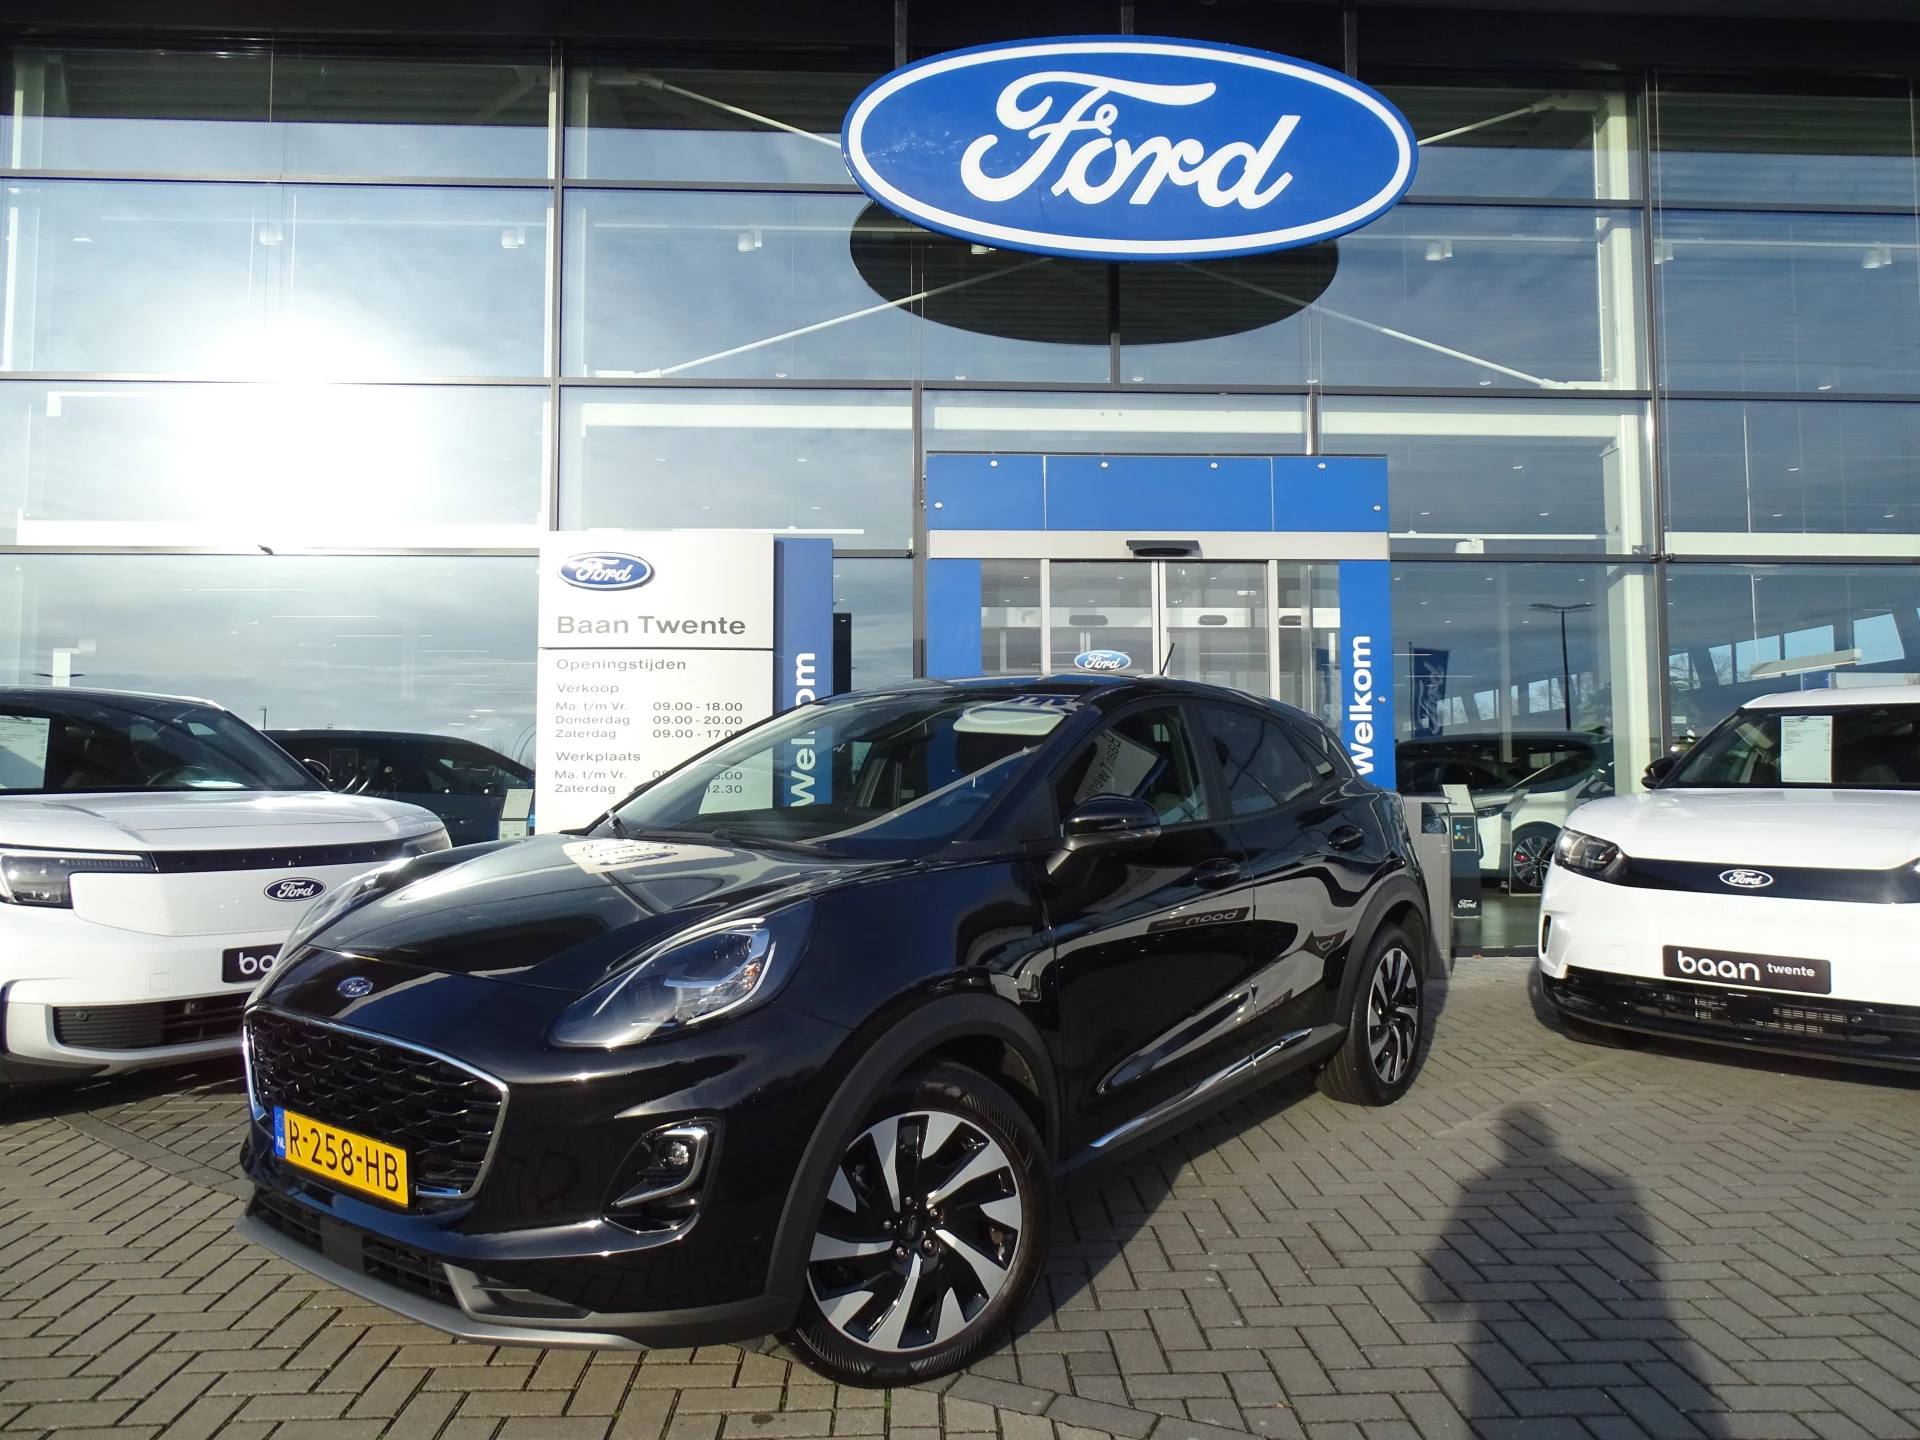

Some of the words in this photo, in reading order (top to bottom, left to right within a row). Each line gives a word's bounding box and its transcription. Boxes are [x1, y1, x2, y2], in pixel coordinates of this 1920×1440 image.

[960, 71, 1301, 209] Ford
[575, 557, 634, 582] Ford
[556, 615, 629, 634] Baan
[637, 615, 746, 635] Twente
[556, 658, 687, 672] Openingstijden
[1084, 653, 1121, 669] Ford
[556, 683, 620, 696] Verkoop
[555, 701, 580, 711] Ma.
[583, 701, 607, 712] t/m
[611, 701, 628, 711] Vr.
[652, 702, 693, 711] 09.00
[705, 702, 743, 712] 18.00
[1349, 635, 1374, 776] Welkom
[555, 715, 631, 726] Donderdag
[652, 716, 693, 725] 09.00
[703, 716, 743, 726] 20.00
[555, 729, 617, 740] Zaterdag
[652, 729, 693, 739] 09.00
[790, 652, 816, 807] Welom
[555, 751, 641, 763] Werkplaats
[554, 770, 579, 779] Ma.
[582, 769, 606, 780] t/m
[610, 770, 627, 779] Vr.
[554, 784, 616, 795] Zaterdag
[707, 784, 743, 794] 12.30
[1728, 871, 1764, 886] Ford
[277, 881, 314, 898] Ford
[238, 952, 277, 975] ba
[1677, 950, 1761, 982] baan
[1766, 962, 1816, 978] twente
[277, 1135, 286, 1149] NL
[288, 1118, 400, 1192] R-258-HB
